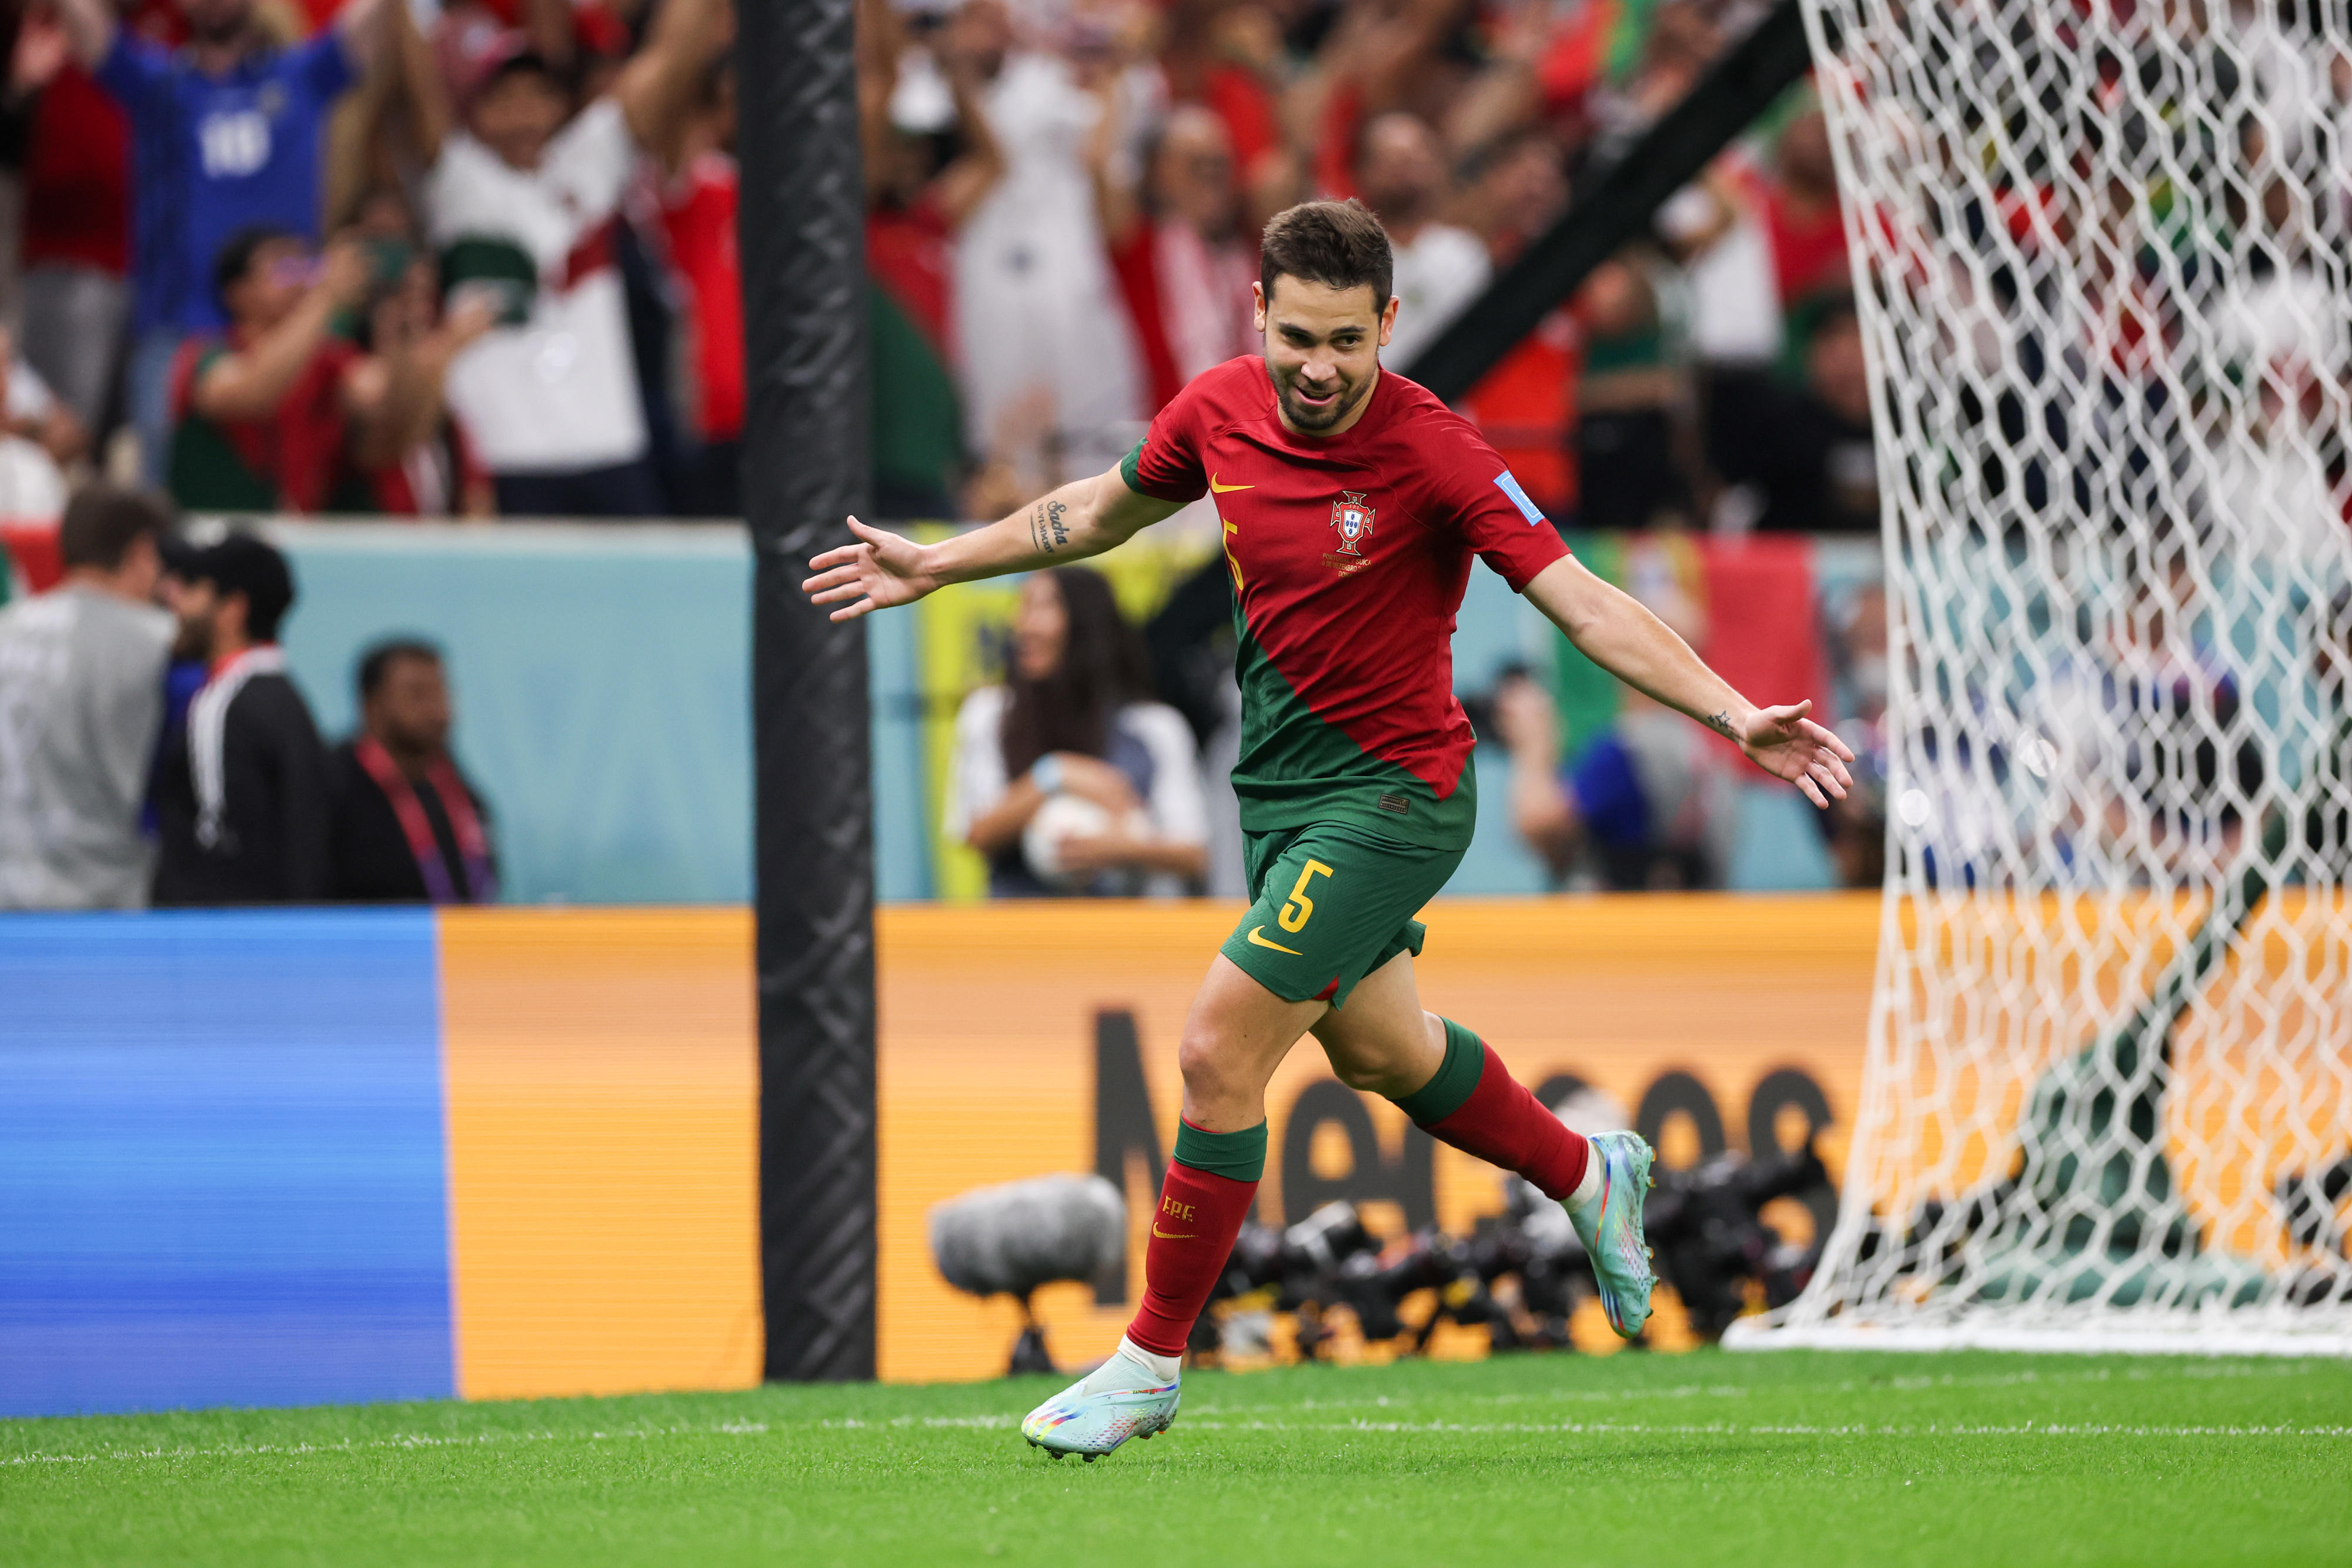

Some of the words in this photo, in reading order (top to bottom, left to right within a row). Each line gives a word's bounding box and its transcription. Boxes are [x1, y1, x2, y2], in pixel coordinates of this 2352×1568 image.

[1047, 501, 1070, 545] Sacha
[1222, 517, 1244, 591] 5
[1322, 553, 1351, 563] PORTUGAL
[1333, 562, 1357, 572] DEZEMBRO
[1278, 859, 1334, 933] 5
